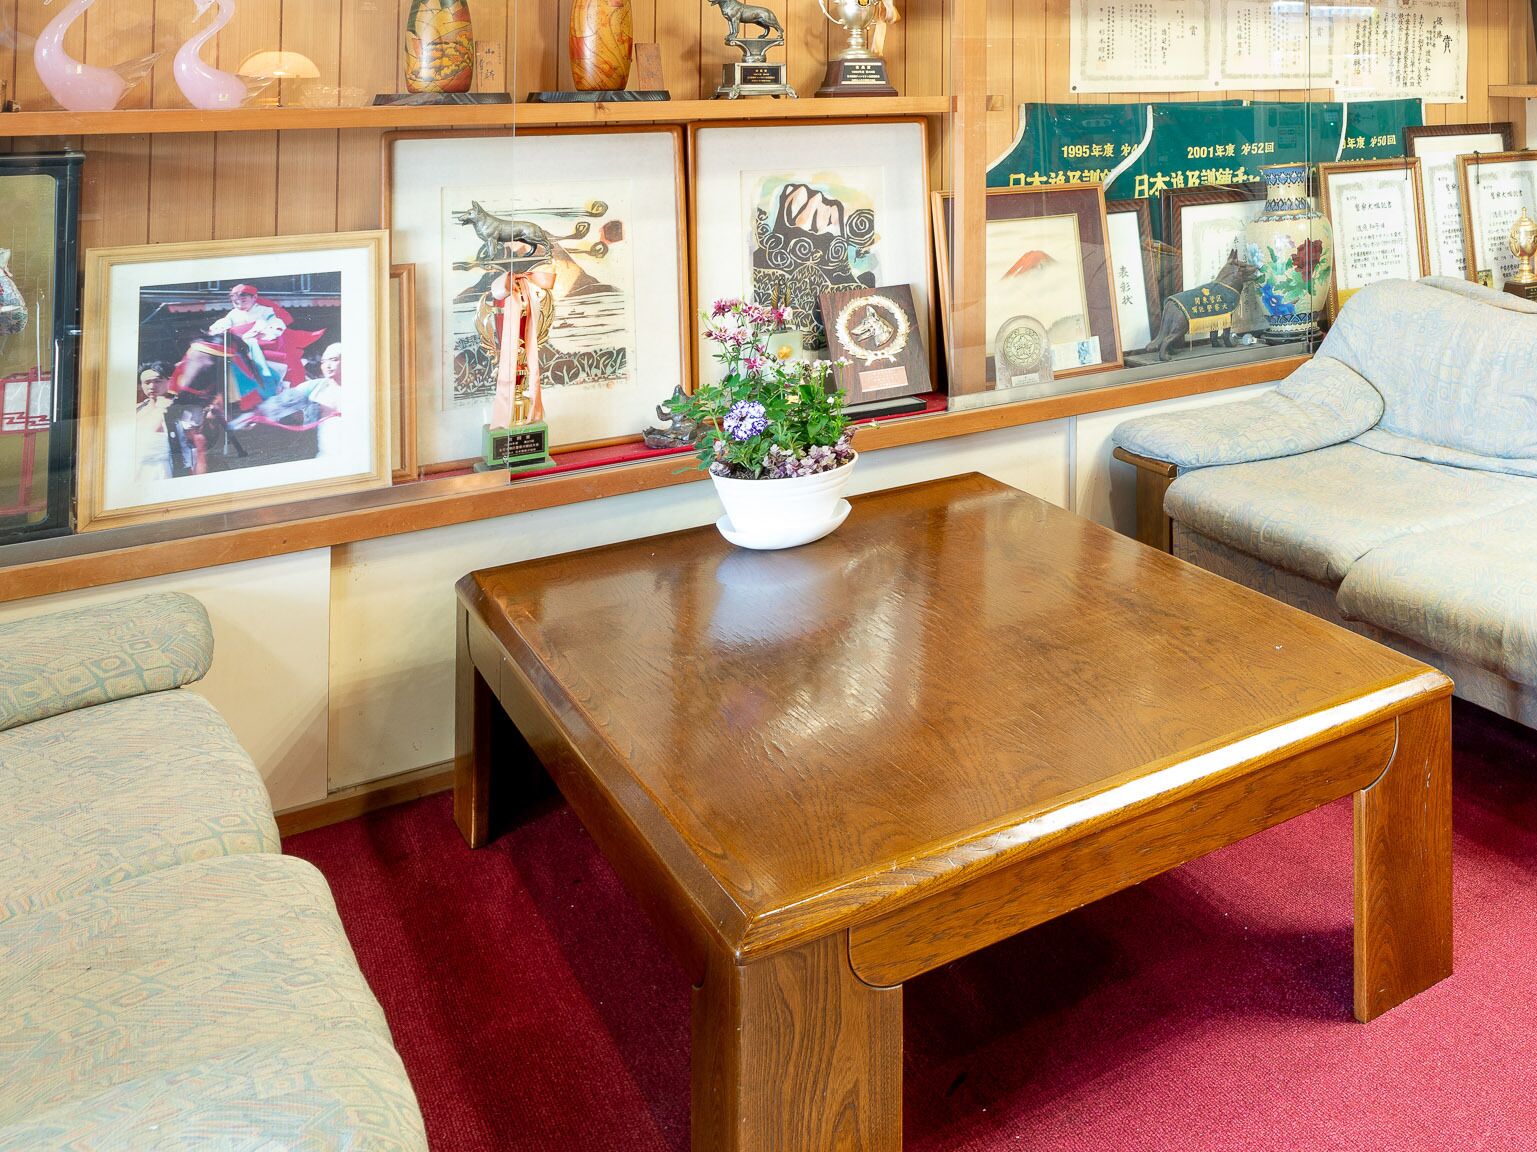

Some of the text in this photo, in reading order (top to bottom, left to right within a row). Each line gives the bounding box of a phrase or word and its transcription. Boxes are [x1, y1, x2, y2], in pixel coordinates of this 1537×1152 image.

[1370, 134, 1397, 148] 第50回
[1062, 143, 1141, 158] 1995年度 第4
[1187, 141, 1275, 159] 2001年度 第52回
[1119, 265, 1134, 305] 表彰状
